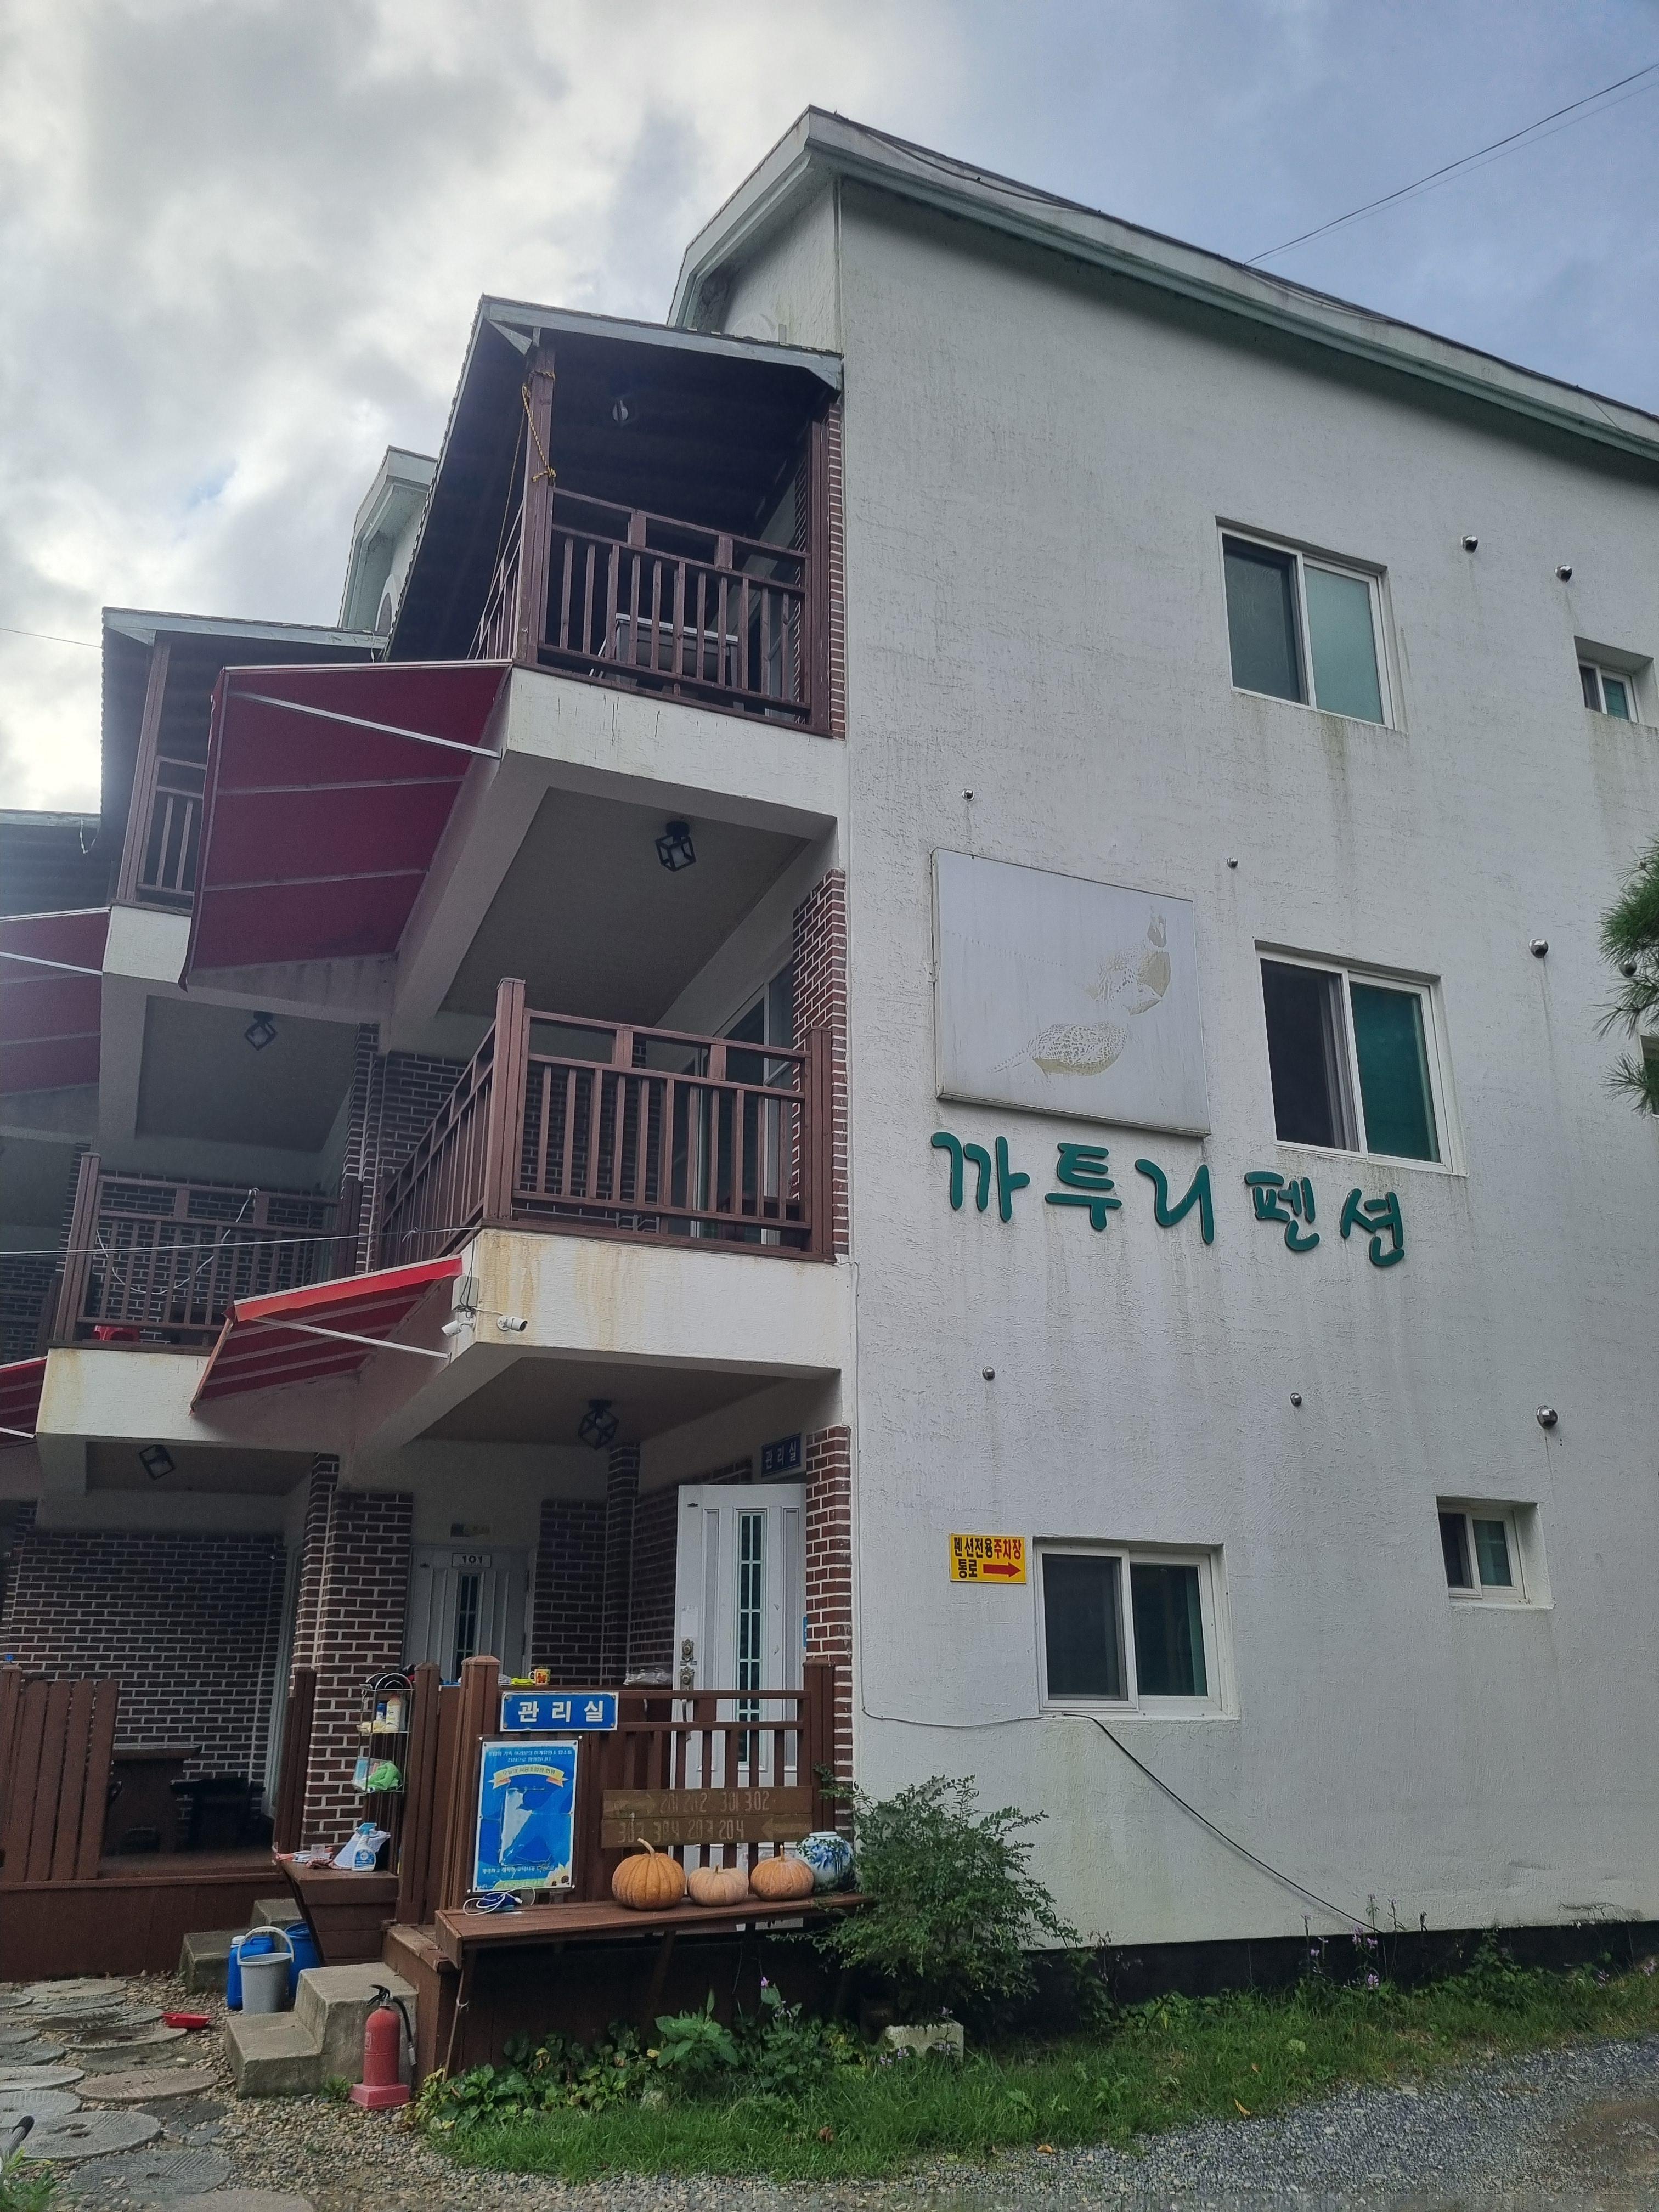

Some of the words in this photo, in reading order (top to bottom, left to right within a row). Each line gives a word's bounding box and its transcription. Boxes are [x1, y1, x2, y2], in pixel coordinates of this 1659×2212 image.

[1245, 1170, 1405, 1267] 펜션
[765, 1441, 796, 1470] 관리실
[462, 1555, 483, 1564] 101
[958, 1559, 978, 1578] 통로
[517, 1700, 604, 1723] 관리실
[659, 1793, 679, 1814] 201
[720, 1791, 739, 1812] 301
[744, 1790, 770, 1812] 302
[719, 1819, 744, 1841] 204
